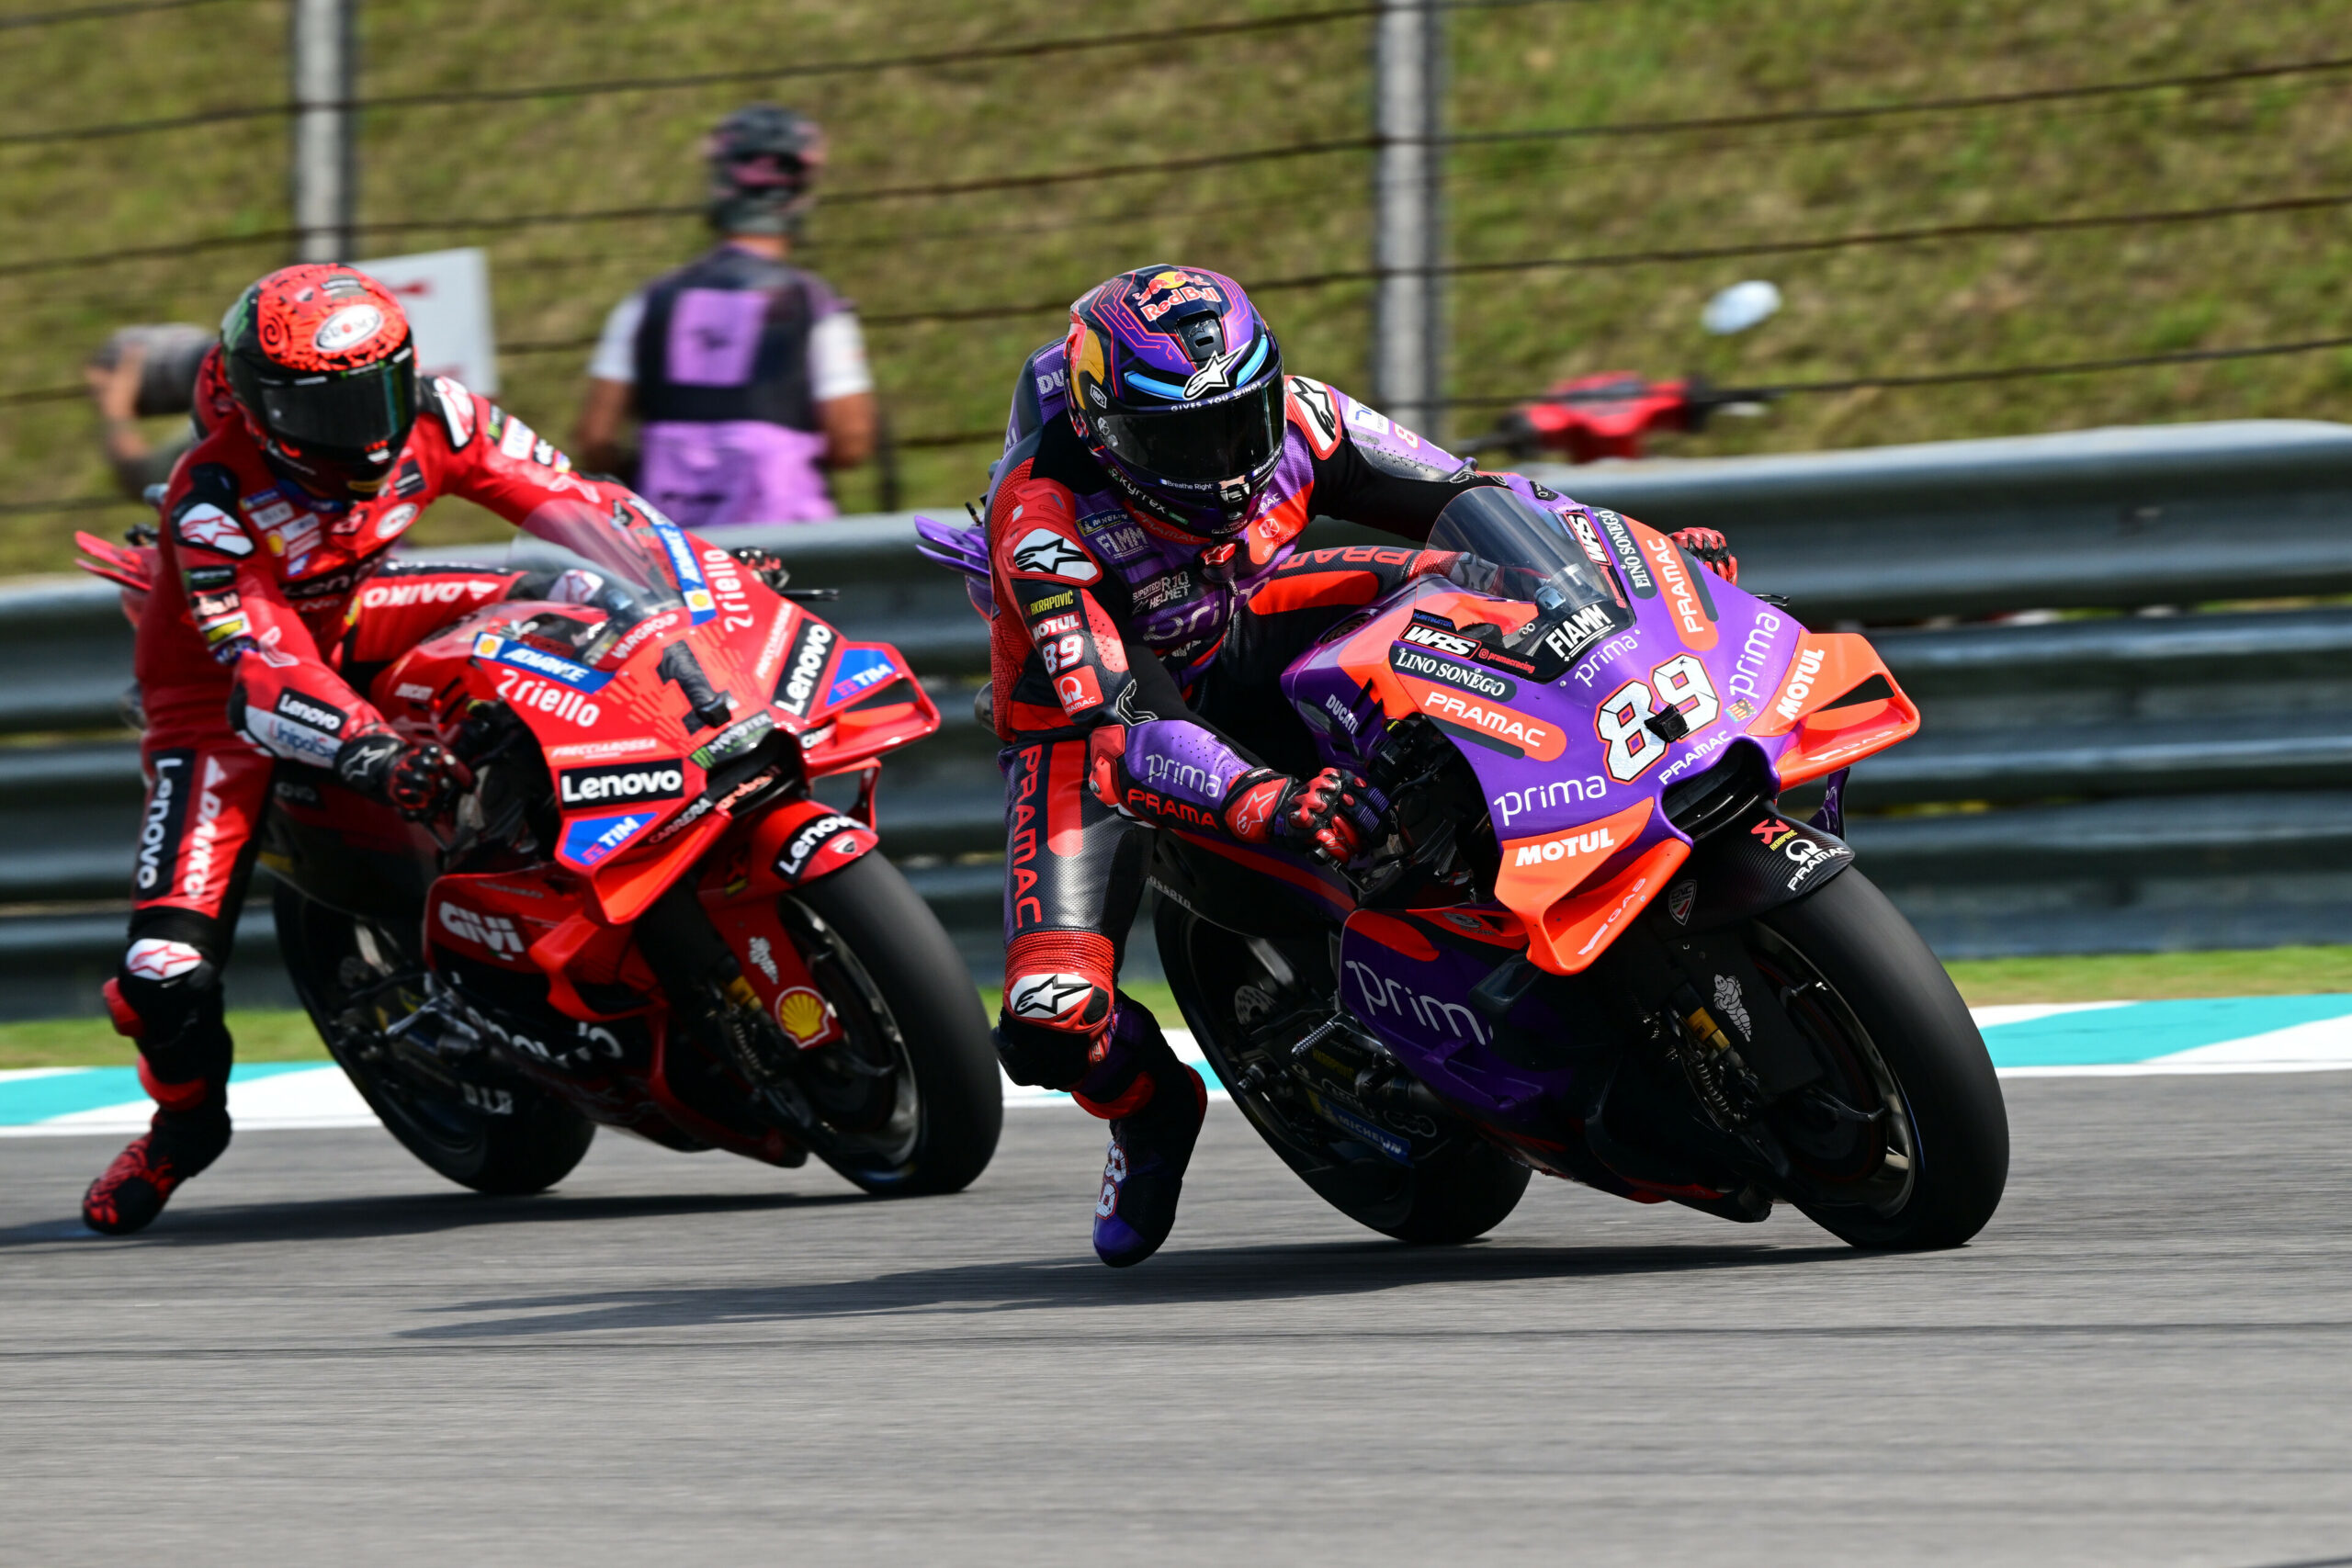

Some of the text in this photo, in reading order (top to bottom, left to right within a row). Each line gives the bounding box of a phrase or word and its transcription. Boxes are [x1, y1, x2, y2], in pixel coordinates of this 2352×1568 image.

[1140, 286, 1222, 321] Red Bull
[1170, 380, 1262, 412] GIVES YOU WINGS
[1167, 479, 1212, 491] Breathe Right
[1599, 510, 1636, 558] SONEGO
[1148, 584, 1191, 610] HELMET
[1646, 537, 1705, 634] PRAMAC
[1033, 615, 1080, 641] MOTUL
[1403, 626, 1478, 656] WRS
[1544, 604, 1612, 659] FIAMM
[775, 624, 832, 716] Lenovo
[851, 662, 894, 686] TIM
[1041, 634, 1084, 676] 89
[1395, 650, 1507, 696] LINO SONEGO
[1574, 635, 1639, 688] prima
[1728, 612, 1781, 699] prima
[1776, 649, 1826, 721] MOTUL
[278, 693, 341, 730] Lenovo
[1325, 694, 1359, 735] DUCATI
[1424, 691, 1547, 748] PRAMAC
[1593, 651, 1724, 787] 89
[1145, 753, 1222, 798] prima
[1657, 730, 1735, 785] PRAMAC
[560, 770, 684, 803] Lenovo
[1127, 788, 1220, 829] PRAMA
[1493, 775, 1608, 827] prima
[138, 758, 184, 889] Lenovo
[598, 816, 641, 848] TIM
[648, 796, 713, 845] CARRERA
[1013, 743, 1043, 930] PRAMAC
[1514, 828, 1615, 867] MOTUL
[1787, 846, 1852, 892] PRAMAC
[438, 900, 526, 953] GIVI
[1345, 961, 1494, 1046] prim
